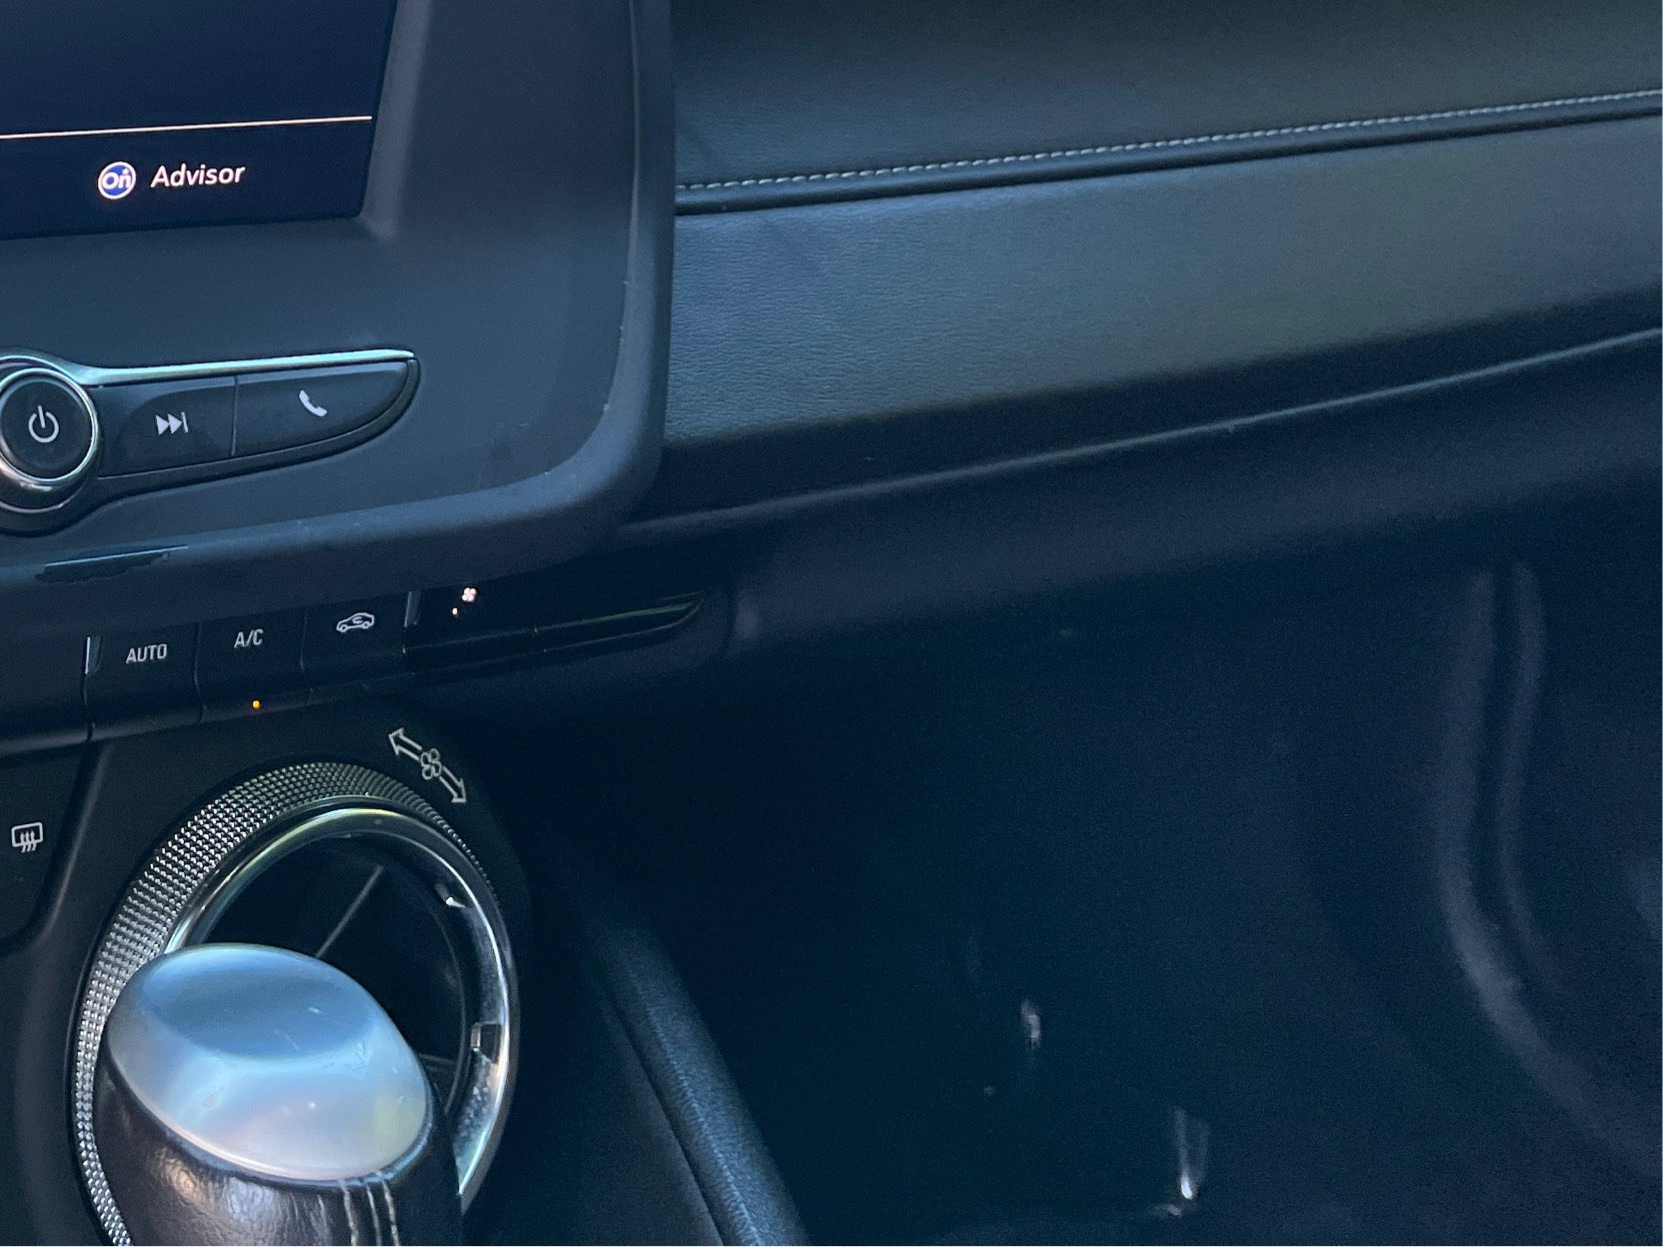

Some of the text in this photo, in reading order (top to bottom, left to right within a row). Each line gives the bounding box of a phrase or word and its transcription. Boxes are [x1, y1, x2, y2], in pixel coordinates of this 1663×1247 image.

[150, 162, 247, 189] Advisor
[233, 628, 264, 649] A/C
[125, 643, 168, 665] AUTO
